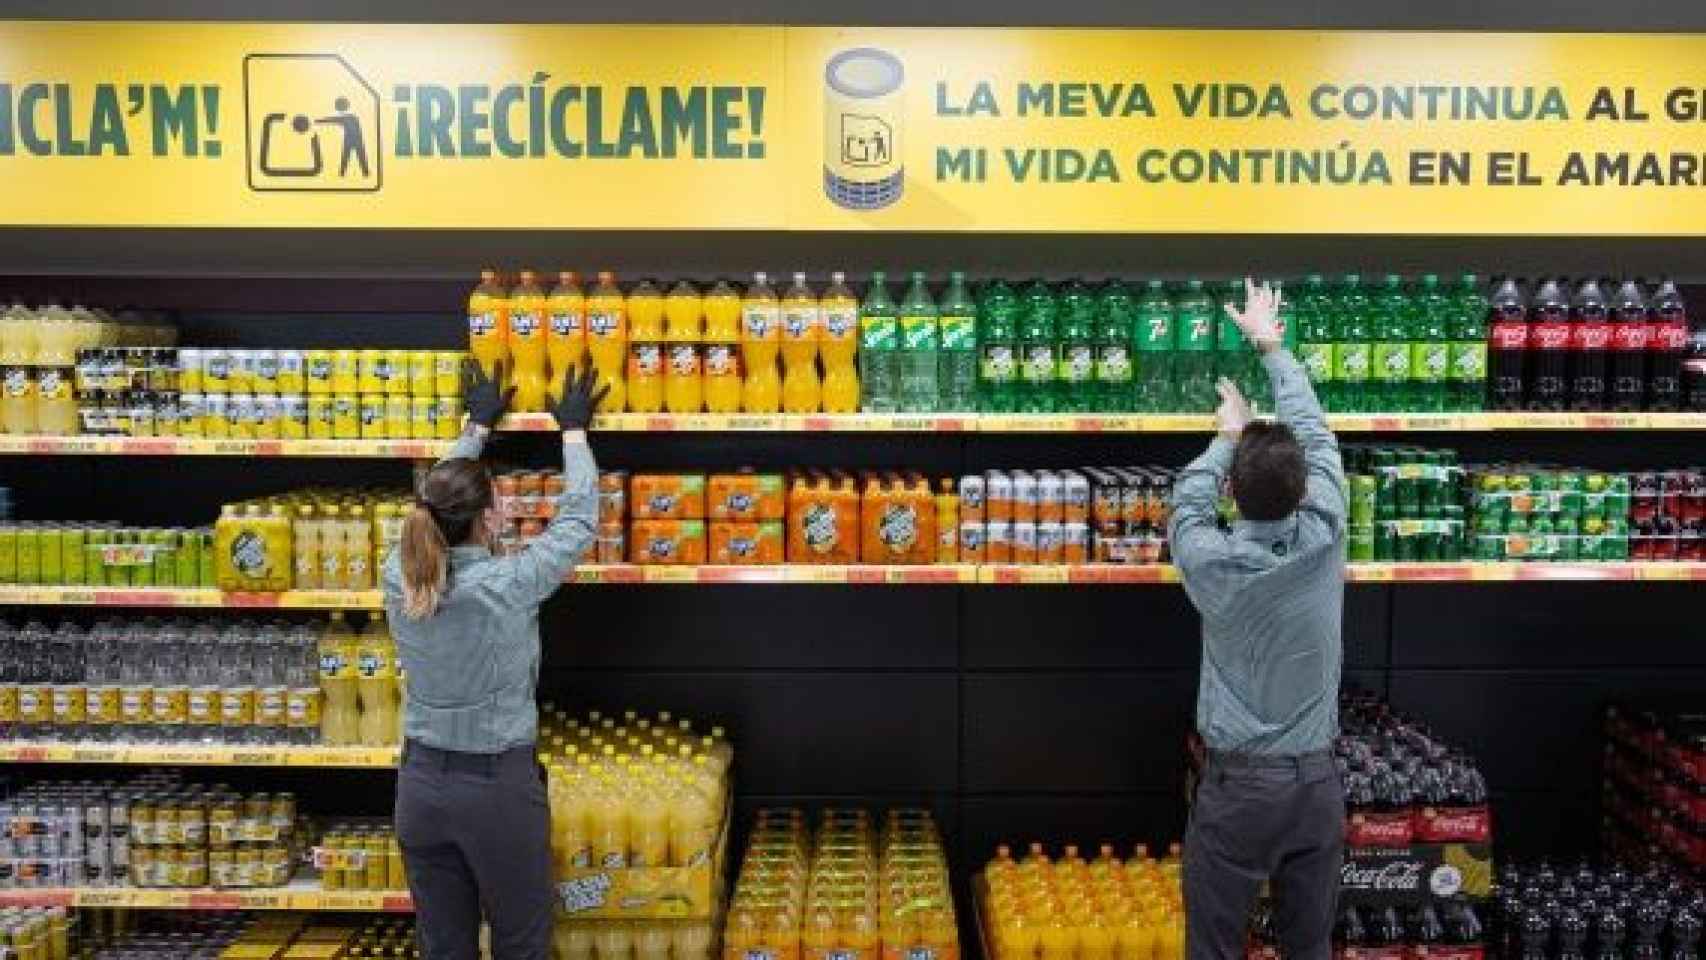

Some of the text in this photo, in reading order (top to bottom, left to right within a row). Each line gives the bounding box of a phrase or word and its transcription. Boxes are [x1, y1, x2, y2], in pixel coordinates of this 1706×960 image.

[395, 72, 767, 159] ¡RECÍCLAME!
[936, 82, 999, 117] LA
[1017, 83, 1155, 118] MEVA
[1172, 84, 1291, 119] VIDA
[1309, 86, 1569, 121] CONTINUA
[1585, 87, 1649, 121] AL
[936, 149, 986, 181] MI
[1004, 150, 1120, 183] VIDA
[1136, 142, 1393, 185] CONTINÚA
[1409, 152, 1471, 186] EN
[1487, 153, 1543, 186] EL
